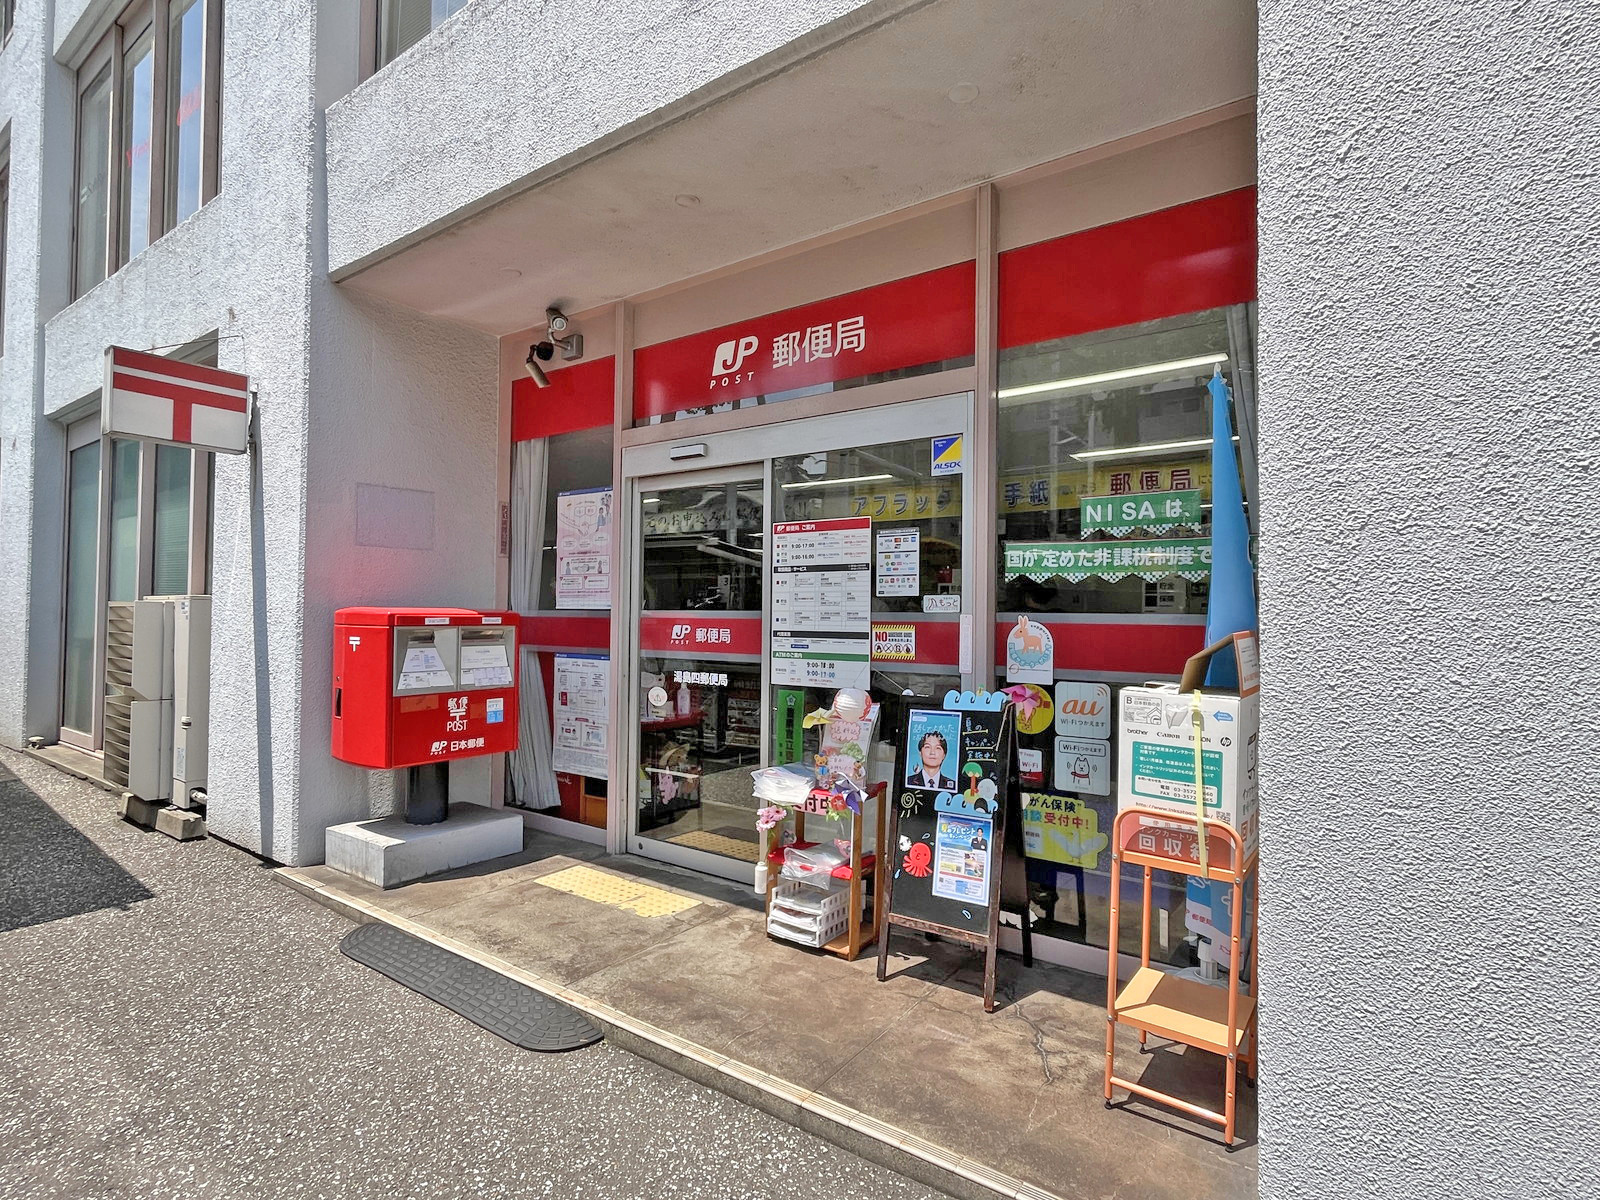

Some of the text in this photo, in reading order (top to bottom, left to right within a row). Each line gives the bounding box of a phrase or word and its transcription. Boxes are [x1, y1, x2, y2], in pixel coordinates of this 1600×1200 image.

[772, 315, 866, 369] 郵便局
[709, 372, 755, 390] POST
[934, 461, 962, 470] ALSOK
[1110, 468, 1192, 495] 郵便局
[1004, 480, 1050, 507] 手紙
[695, 628, 731, 644] 郵便局
[875, 631, 888, 642] NO
[673, 670, 728, 687] 湯島四郵便局
[448, 696, 468, 711] 郵便
[1062, 699, 1105, 716] au
[446, 720, 469, 732] POST
[1127, 728, 1149, 736] brother
[1156, 732, 1181, 740] Canon
[1188, 735, 1212, 744] EON
[451, 737, 485, 752] 日本郵便
[792, 794, 831, 814] 付中
